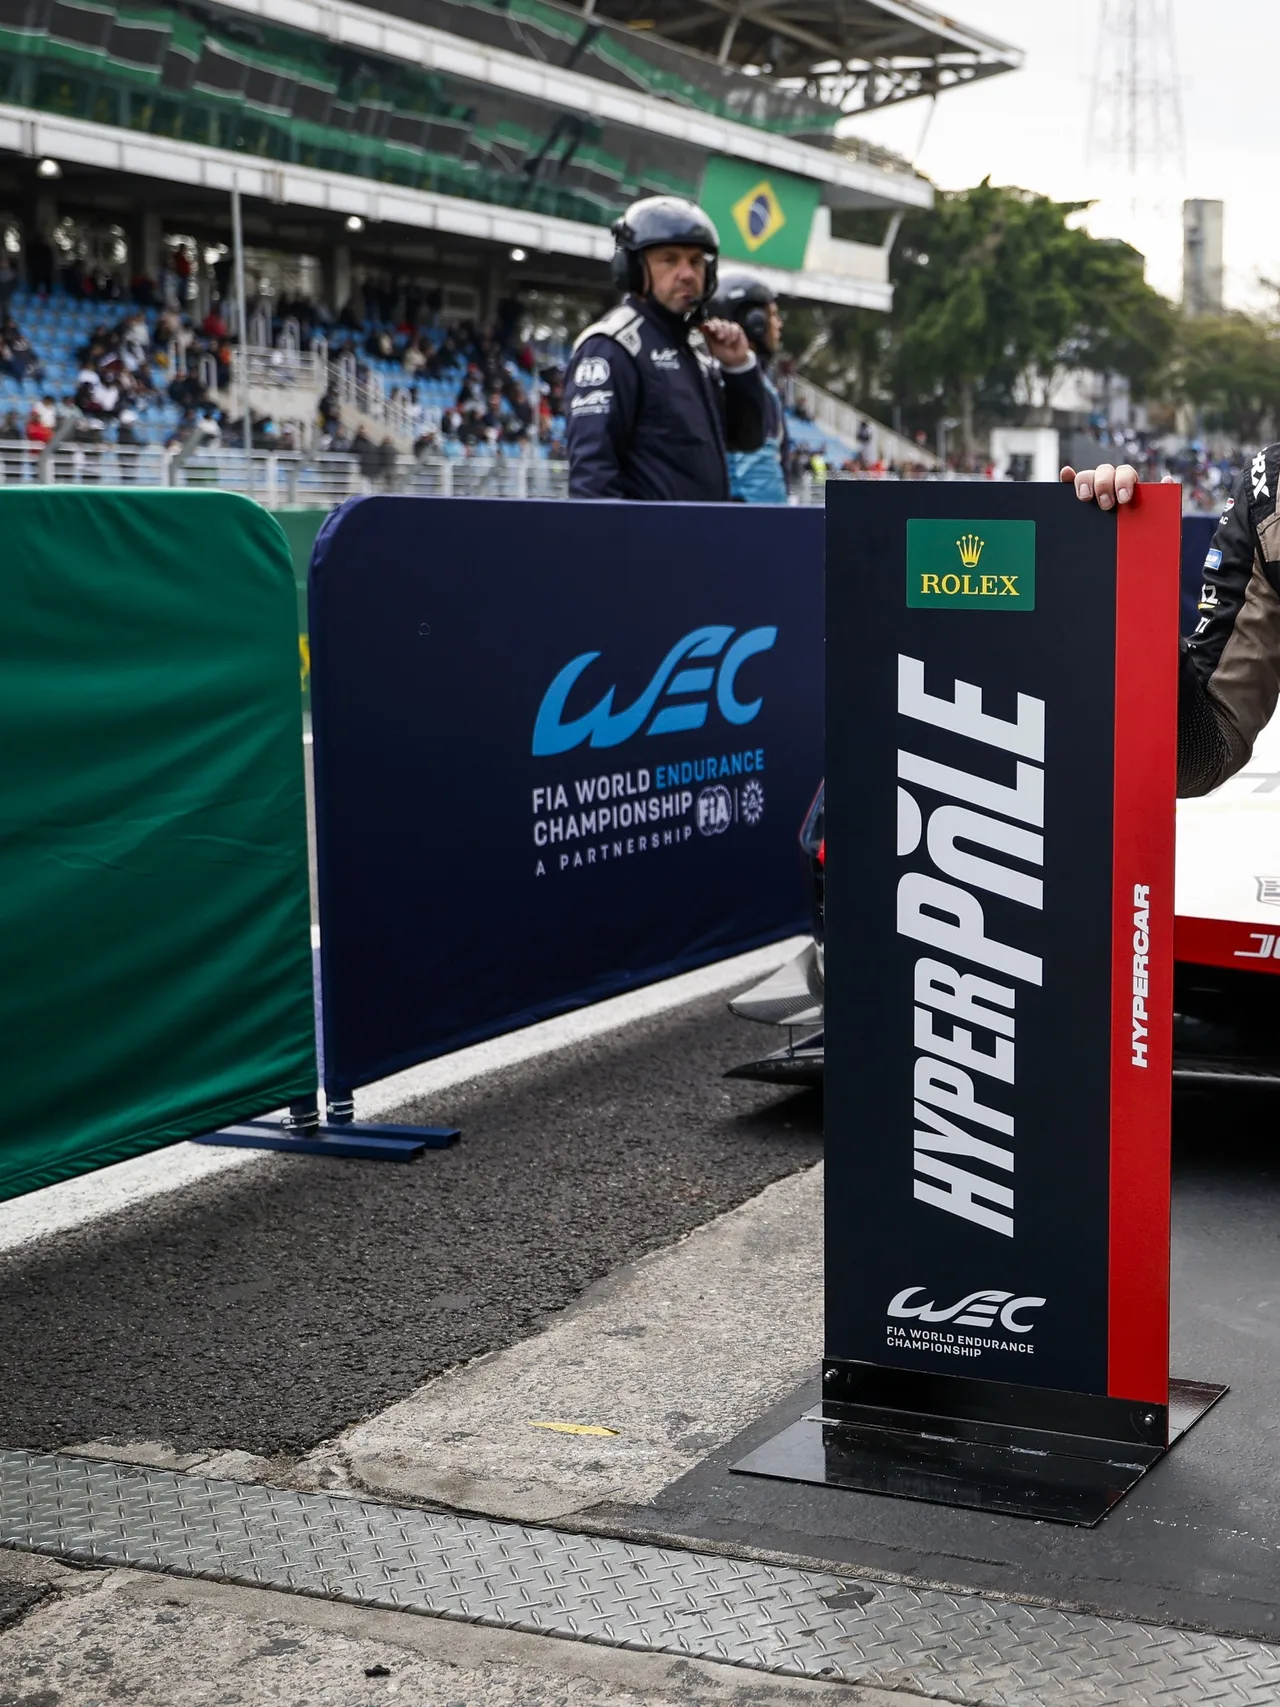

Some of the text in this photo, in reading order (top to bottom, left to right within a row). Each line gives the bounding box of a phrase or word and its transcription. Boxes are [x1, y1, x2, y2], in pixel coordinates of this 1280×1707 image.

[574, 360, 606, 386] FIA
[920, 573, 1020, 597] ROLEX
[532, 624, 778, 757] WEC
[532, 748, 765, 814] FIA WORLD ENDURANCE
[533, 790, 693, 847] CHAMPIONSHIP
[536, 825, 693, 877] A PARTNERSHIP
[1131, 883, 1151, 1068] HYPERCAR
[886, 1286, 1047, 1333] WEC
[886, 1325, 1035, 1354] FIA WORLD ENDURANCE
[886, 1336, 982, 1358] CHAMPIONSHIP
